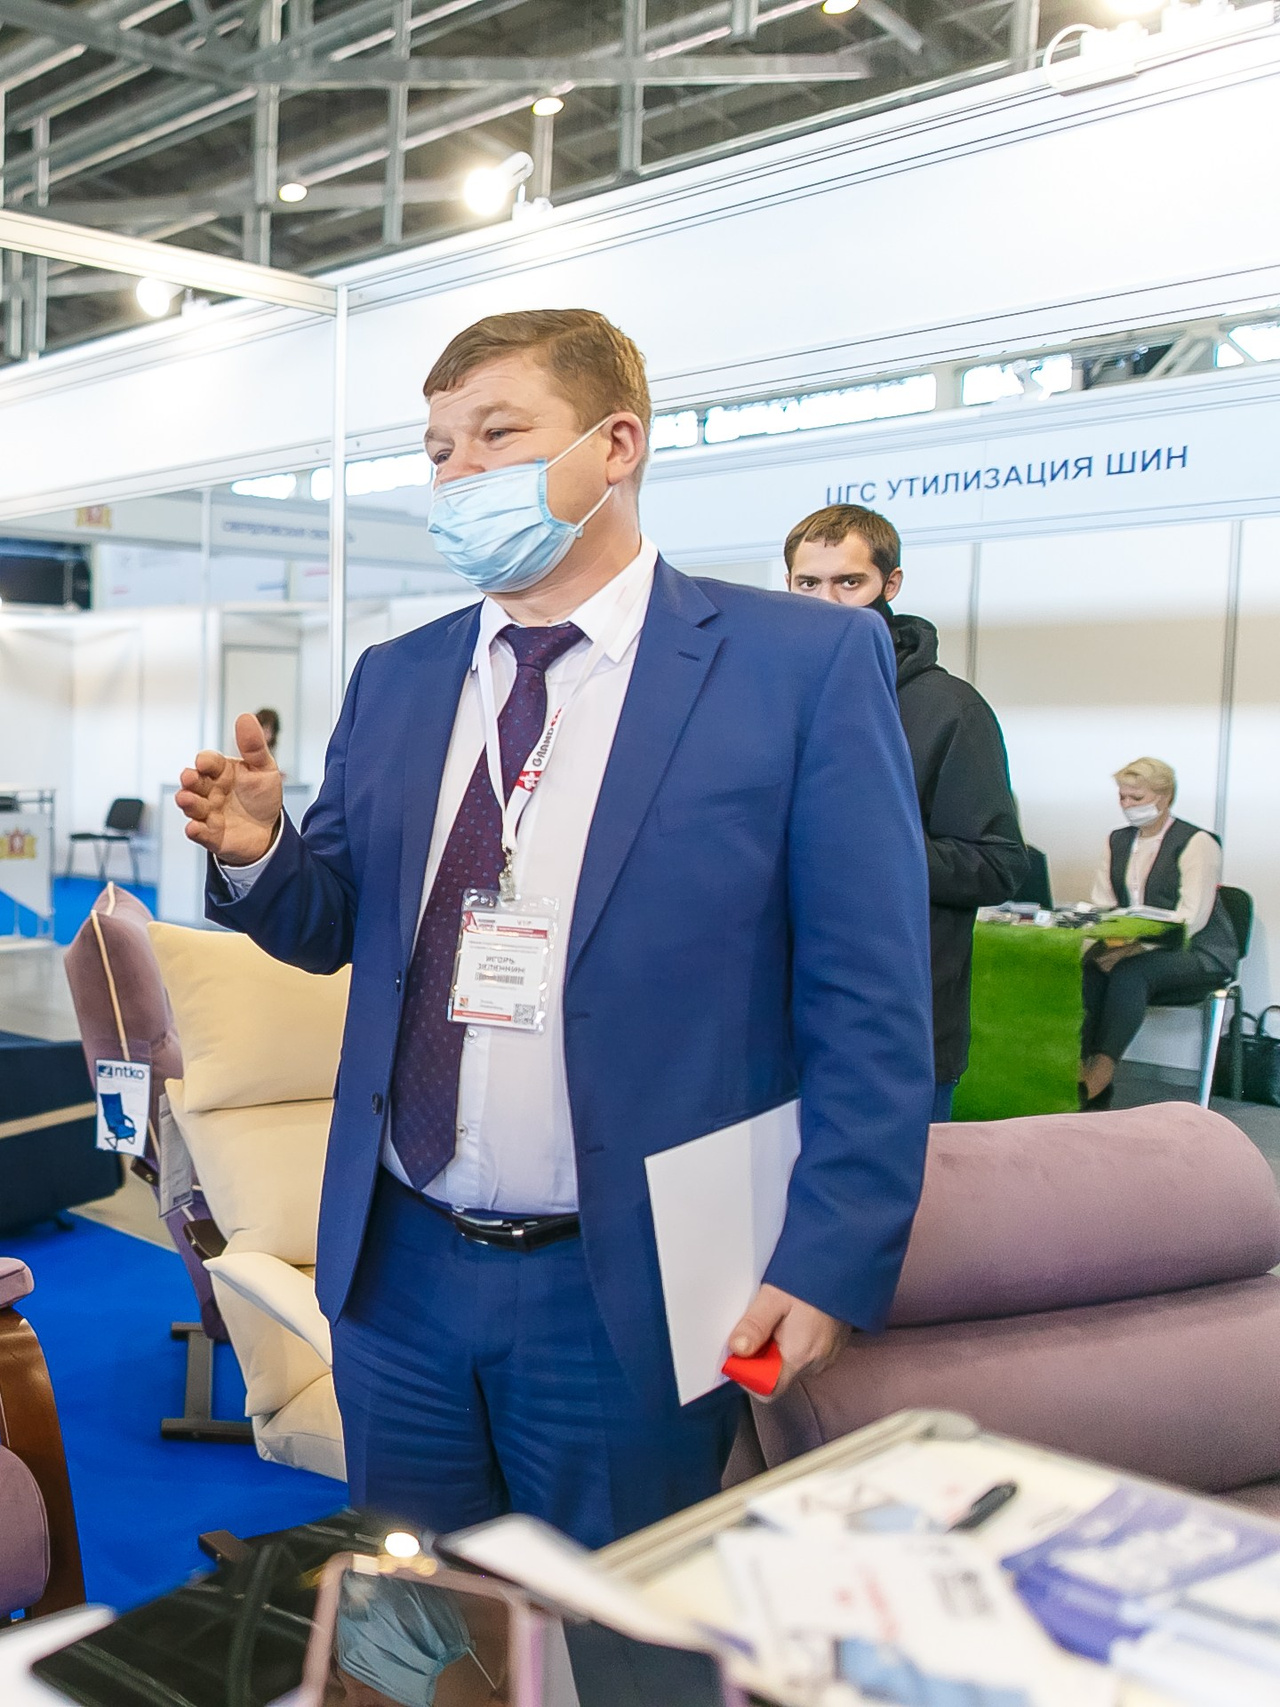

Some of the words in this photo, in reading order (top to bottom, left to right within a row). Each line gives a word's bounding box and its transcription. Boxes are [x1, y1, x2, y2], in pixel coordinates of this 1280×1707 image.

[826, 482, 877, 506] ЦГС
[886, 456, 1094, 500] УТИЛИЗАЦИЯ
[1106, 445, 1188, 476] ШИН
[115, 1066, 145, 1080] ntko
